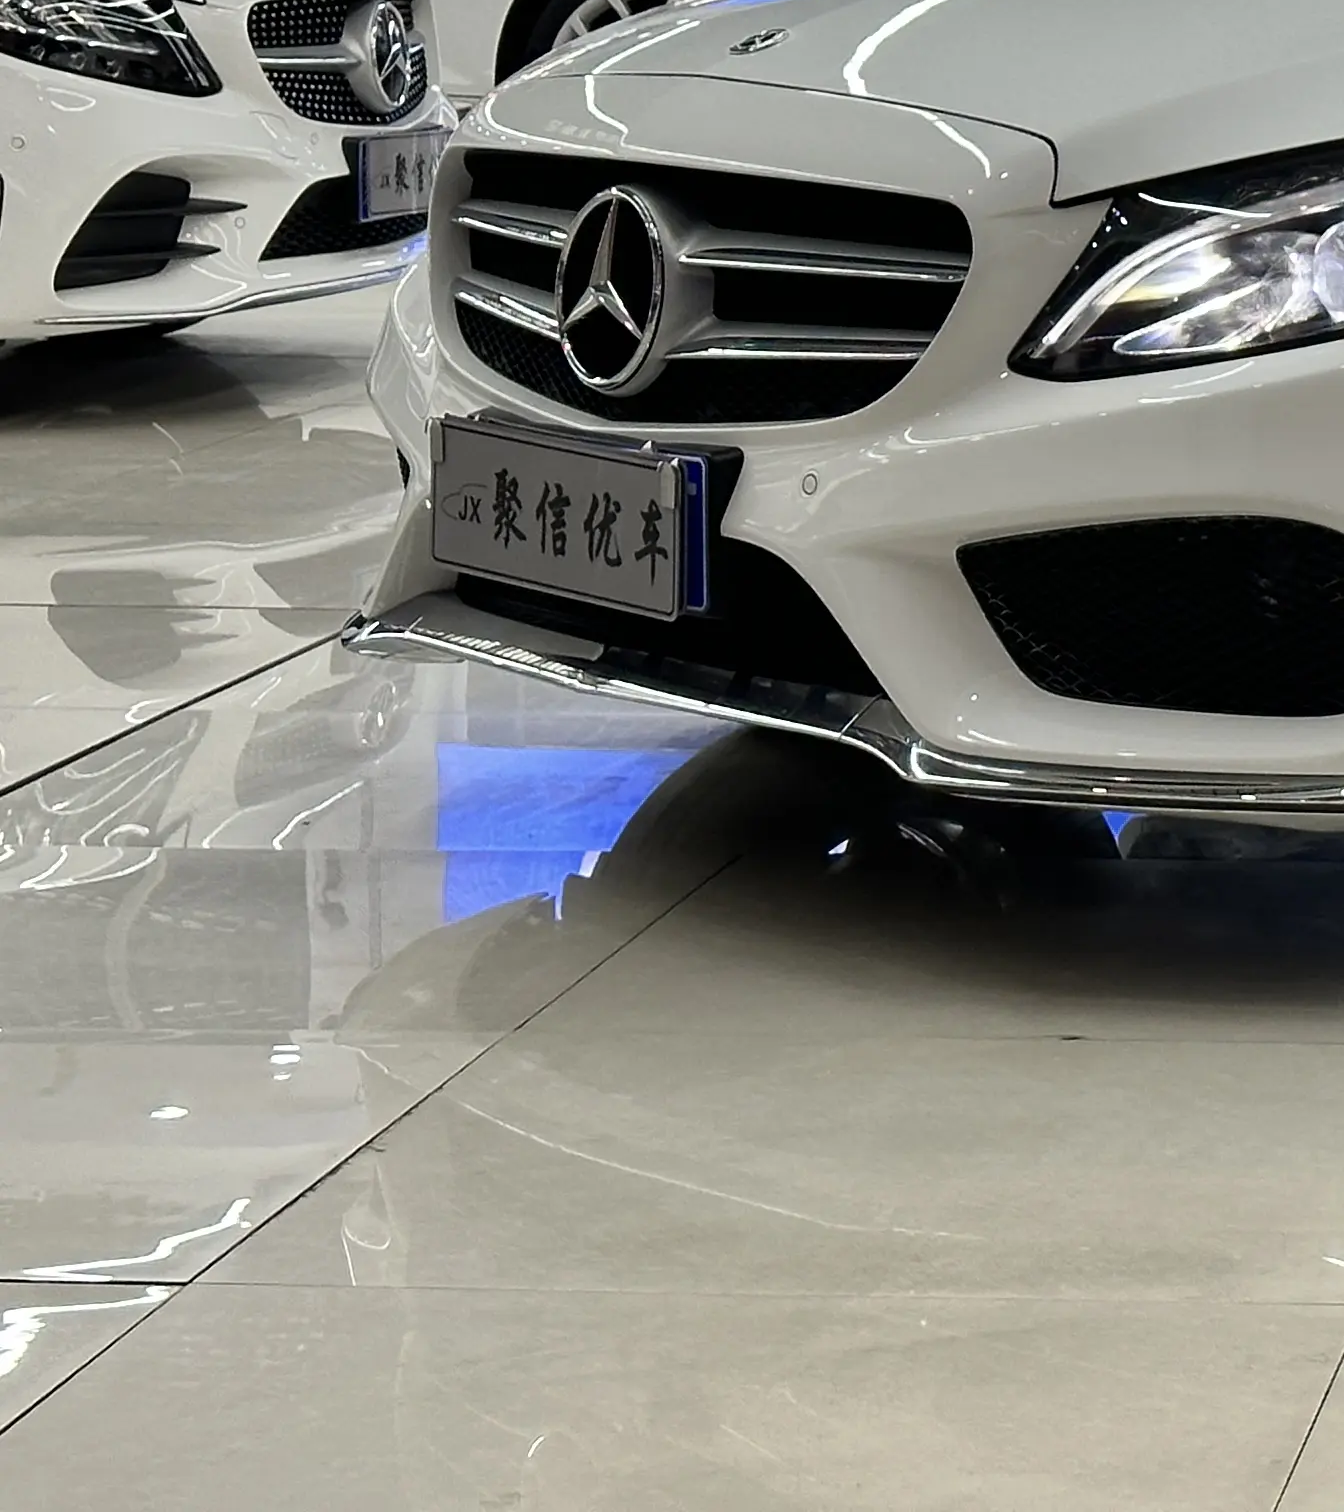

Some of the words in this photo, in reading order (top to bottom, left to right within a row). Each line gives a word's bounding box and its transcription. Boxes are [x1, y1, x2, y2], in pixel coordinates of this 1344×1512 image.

[458, 495, 482, 524] JX
[491, 467, 669, 587] 聚信优车
